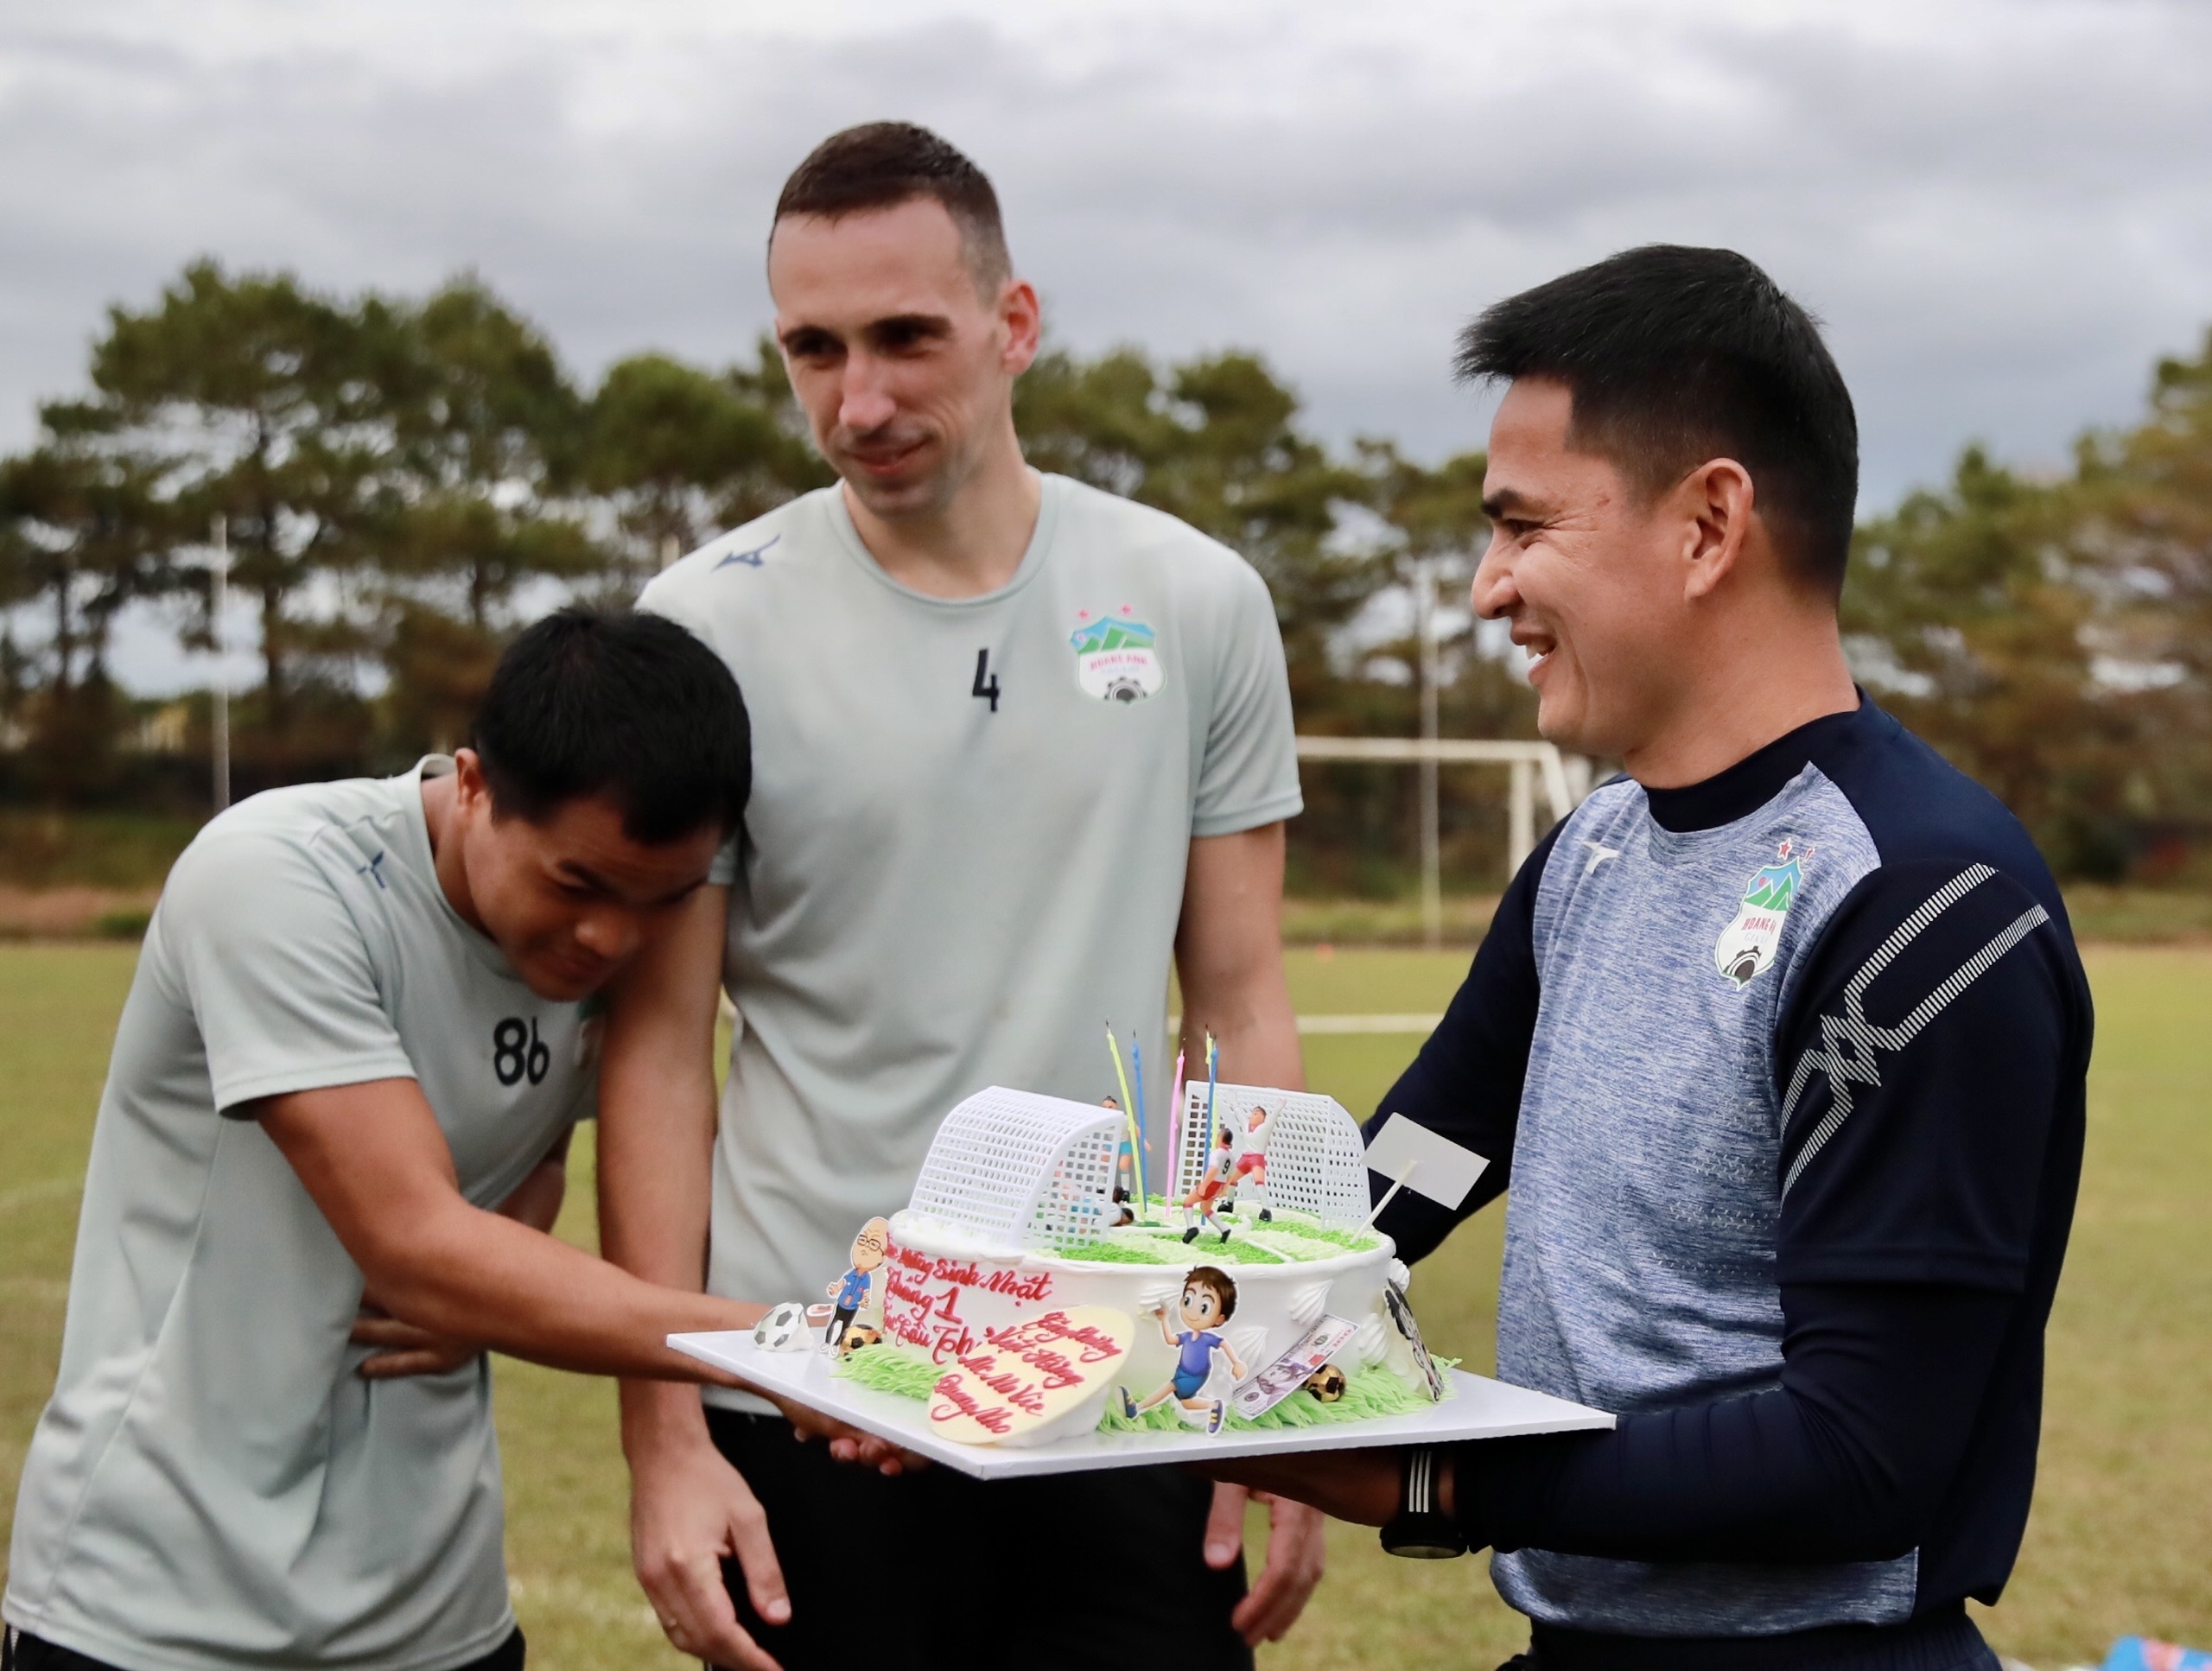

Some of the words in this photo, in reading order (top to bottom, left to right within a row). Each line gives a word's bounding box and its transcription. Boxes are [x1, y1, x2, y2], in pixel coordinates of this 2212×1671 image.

[972, 649, 1000, 714] 4
[493, 1016, 550, 1086] 86
[1222, 1158, 1230, 1175] 9
[933, 1258, 982, 1286] Sinh
[979, 1270, 1052, 1307] Nhật
[935, 1286, 963, 1325] 1
